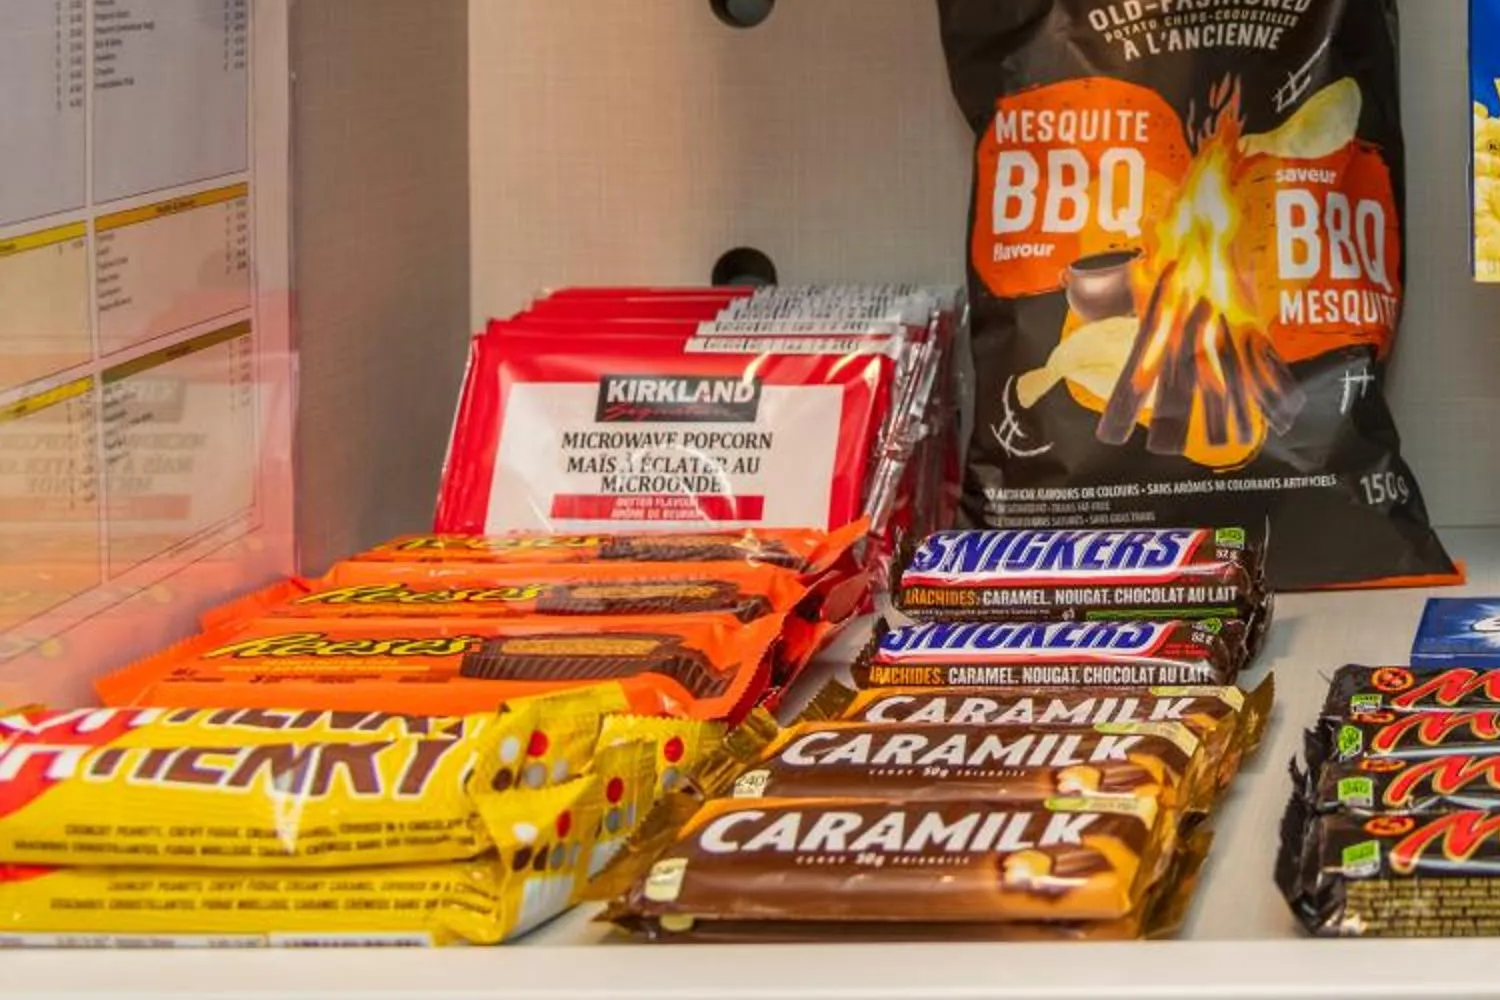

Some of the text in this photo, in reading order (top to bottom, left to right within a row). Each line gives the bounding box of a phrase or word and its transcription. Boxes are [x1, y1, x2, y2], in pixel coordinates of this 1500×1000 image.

[1103, 20, 1158, 43] POTATO
[1146, 23, 1285, 55] L'ANCIENNE
[995, 110, 1150, 144] MESQUITE
[1275, 167, 1338, 186] saveur
[991, 147, 1145, 237] BBQ
[992, 242, 1055, 262] flavour
[1275, 190, 1395, 294] BBQ
[607, 378, 755, 404] KIRKLAND
[561, 431, 773, 450] MICROWAVE POPCORN
[566, 453, 617, 474] MAÏS
[730, 456, 761, 474] AU
[1097, 484, 1140, 498] COLOURS
[1147, 482, 1172, 495] SANS
[912, 528, 1189, 573] SNICKERS
[1114, 585, 1238, 604] CHOCOLAT AU LAIT
[1083, 664, 1156, 683] CHOCOLAT
[1158, 664, 1180, 682] AU
[864, 695, 1202, 725] CARAMILK
[781, 731, 1146, 767] CARAMILK
[700, 811, 1104, 854] CARAMILK
